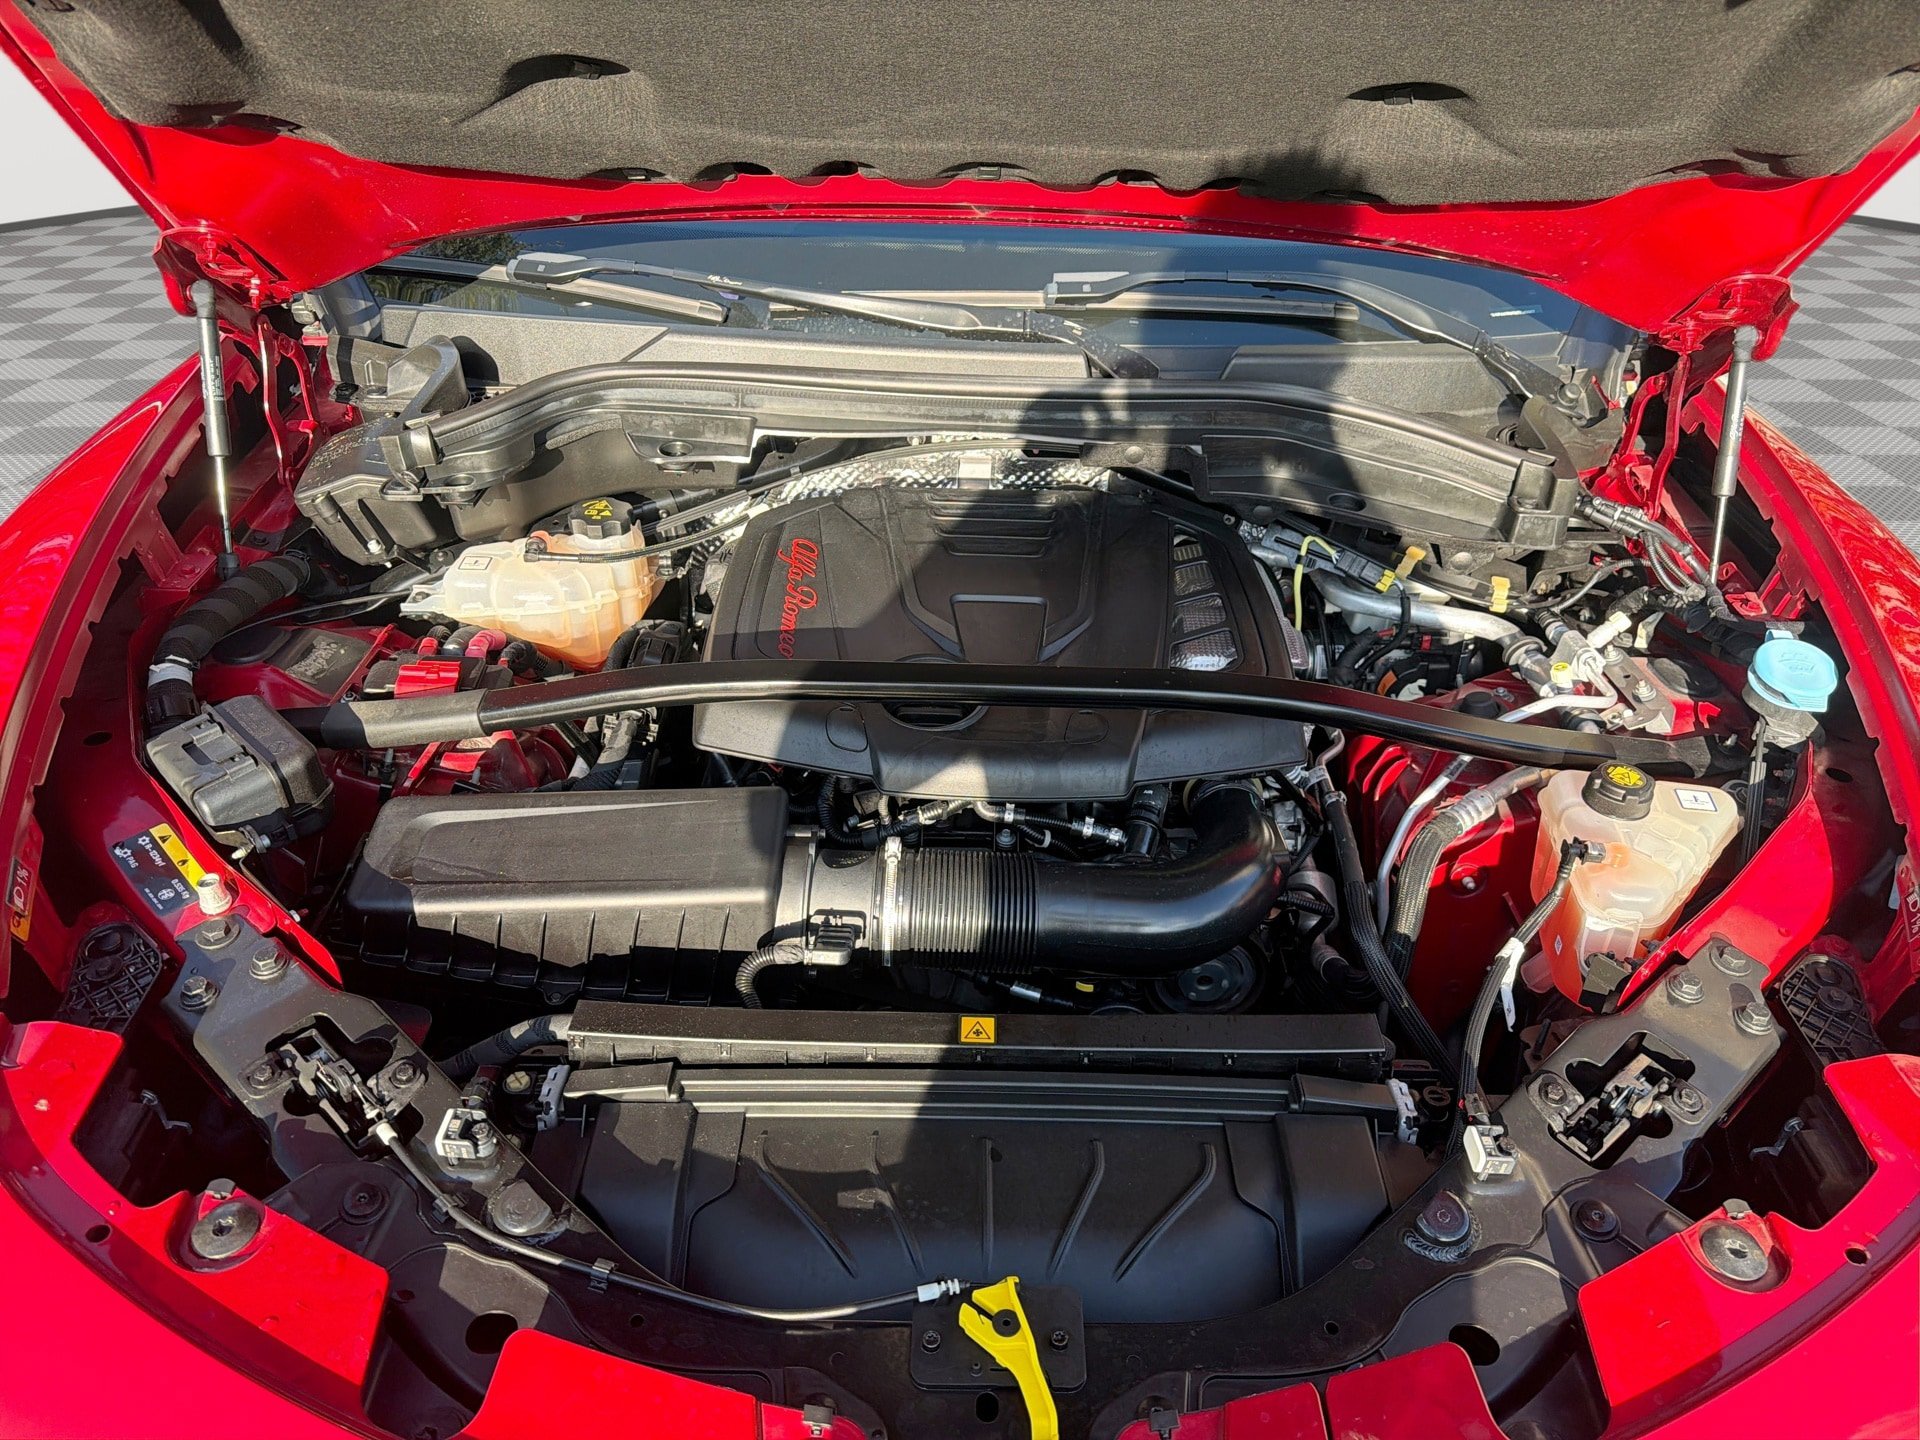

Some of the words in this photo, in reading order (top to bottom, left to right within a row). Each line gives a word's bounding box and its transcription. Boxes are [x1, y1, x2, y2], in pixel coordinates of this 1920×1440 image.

[778, 538, 818, 584] Alfa
[778, 583, 817, 660] Romeo
[16, 866, 28, 886] 1%
[126, 855, 139, 868] PAG
